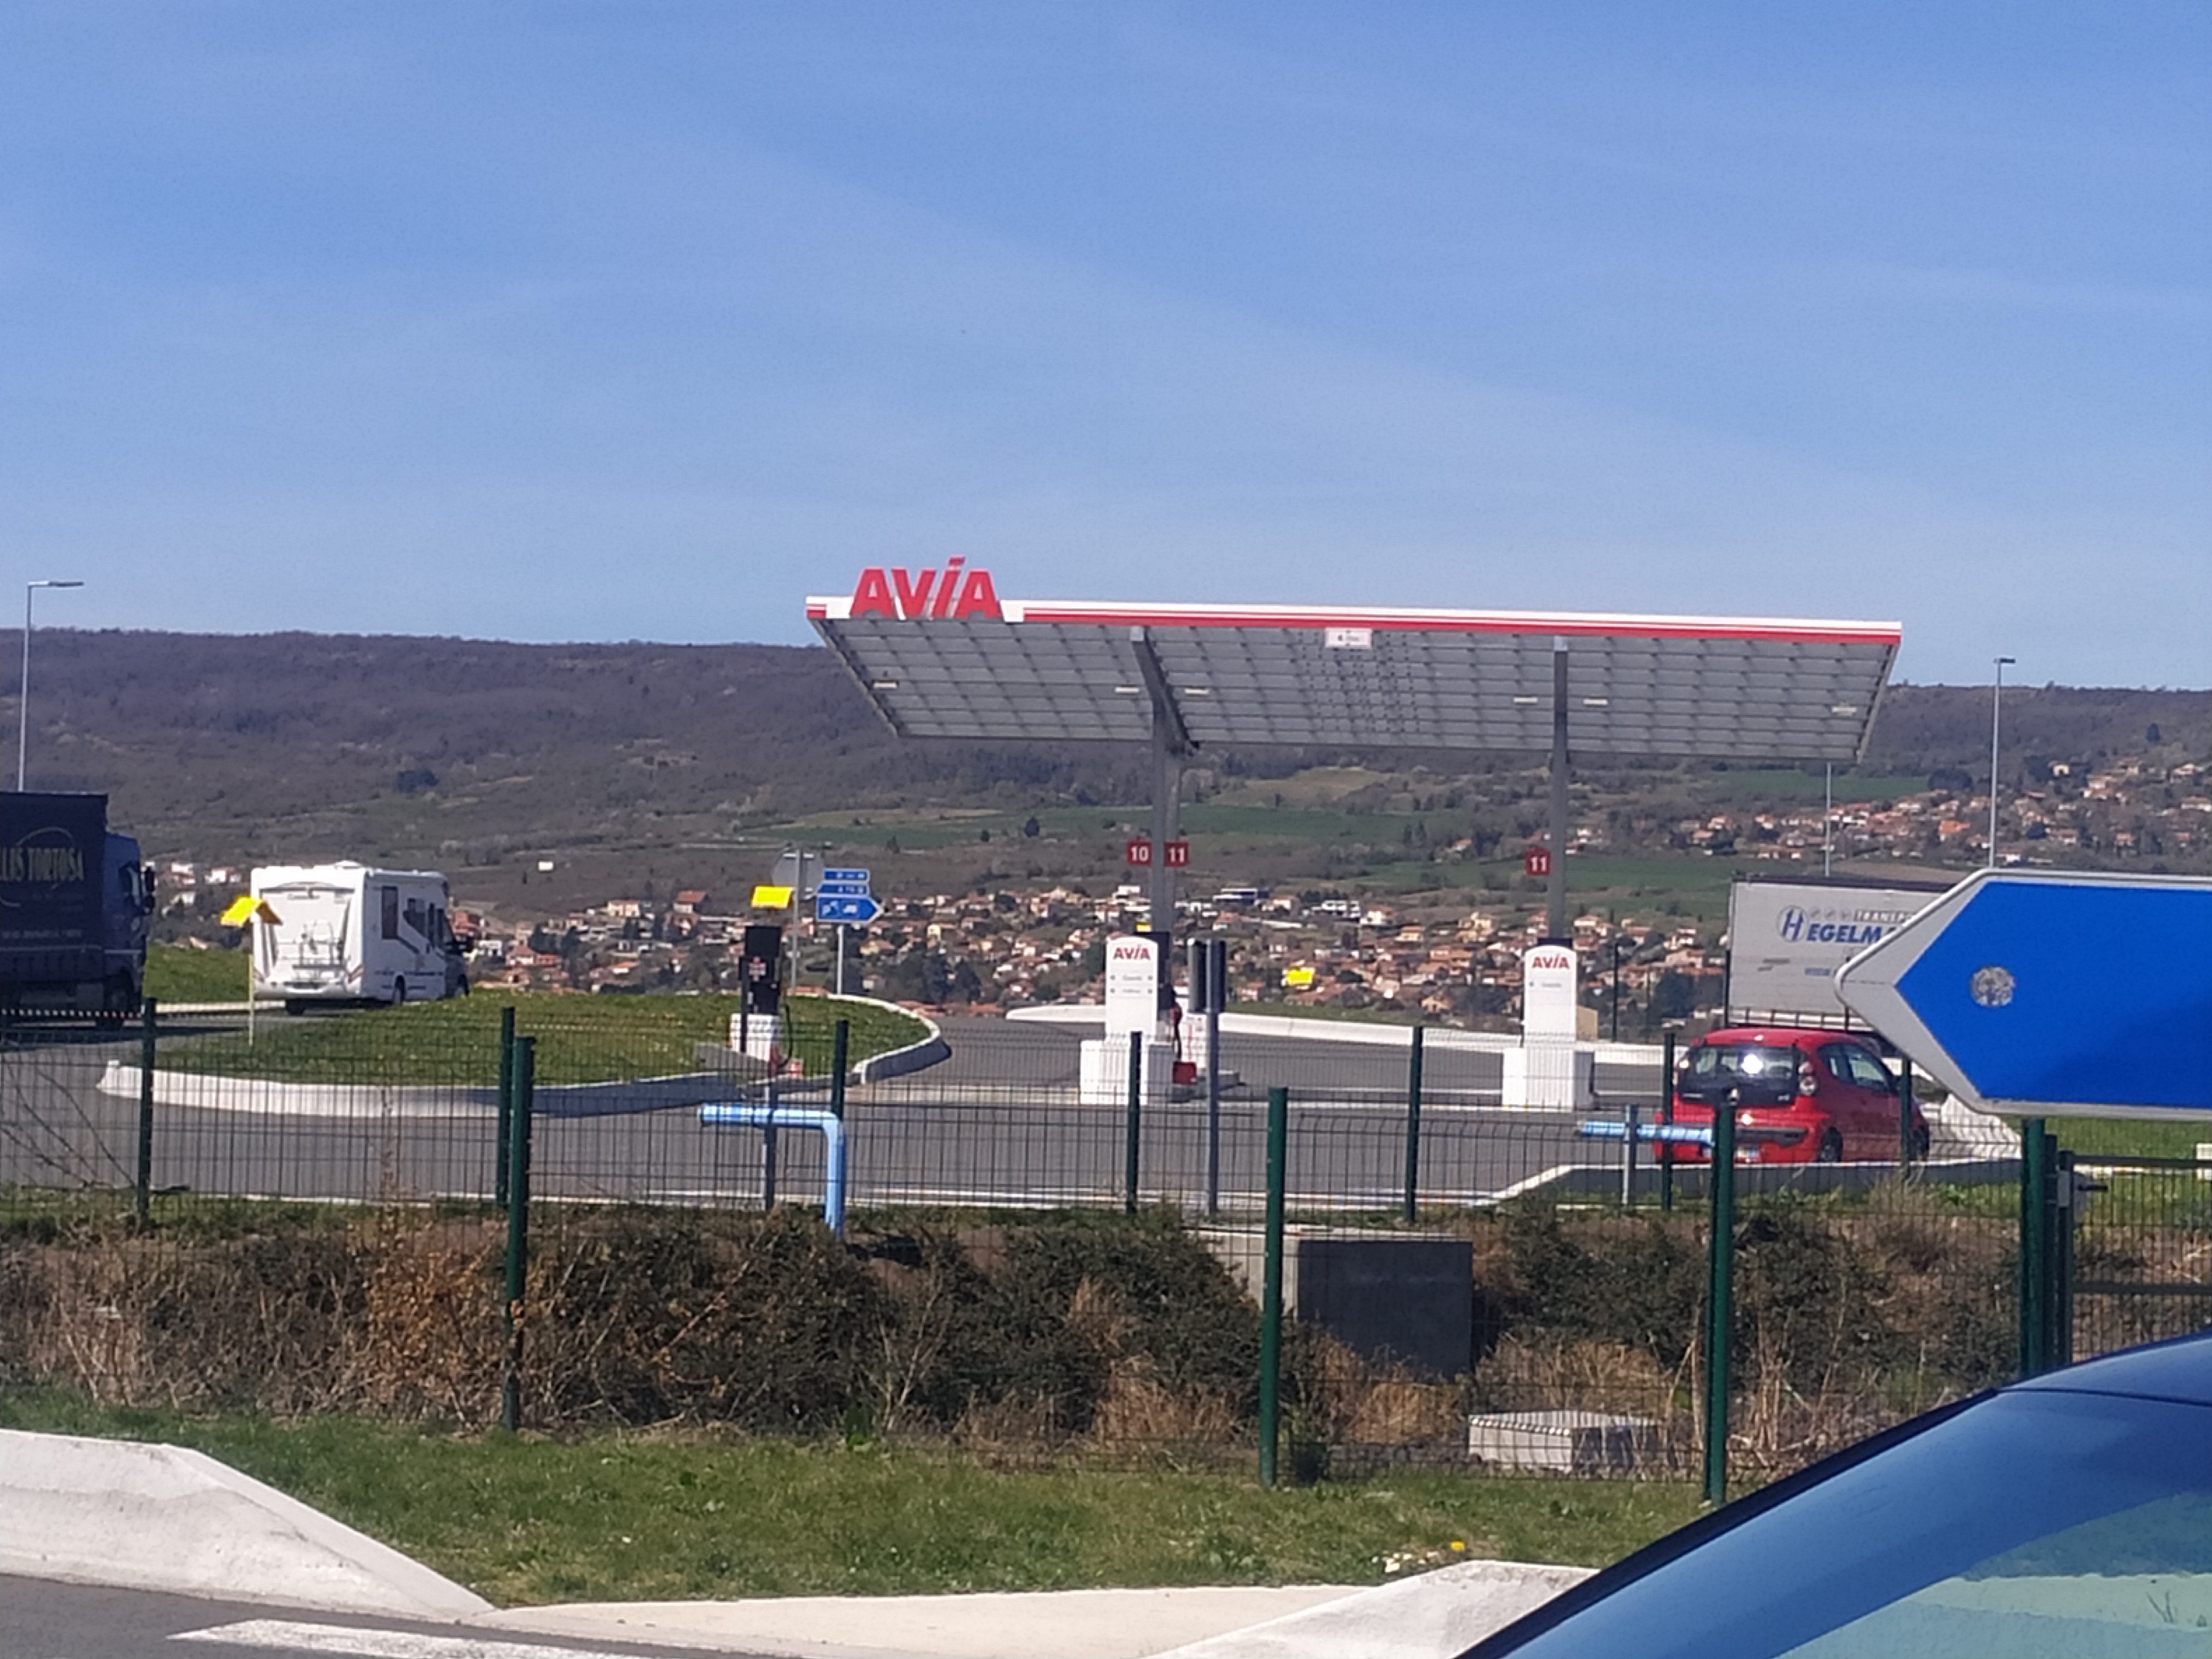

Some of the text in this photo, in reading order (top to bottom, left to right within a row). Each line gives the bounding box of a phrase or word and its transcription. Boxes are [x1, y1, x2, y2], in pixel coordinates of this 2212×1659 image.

[1131, 846, 1149, 861] 10
[1168, 848, 1185, 863] 11
[1530, 856, 1547, 872] 11
[1780, 908, 1897, 942] HEGELM
